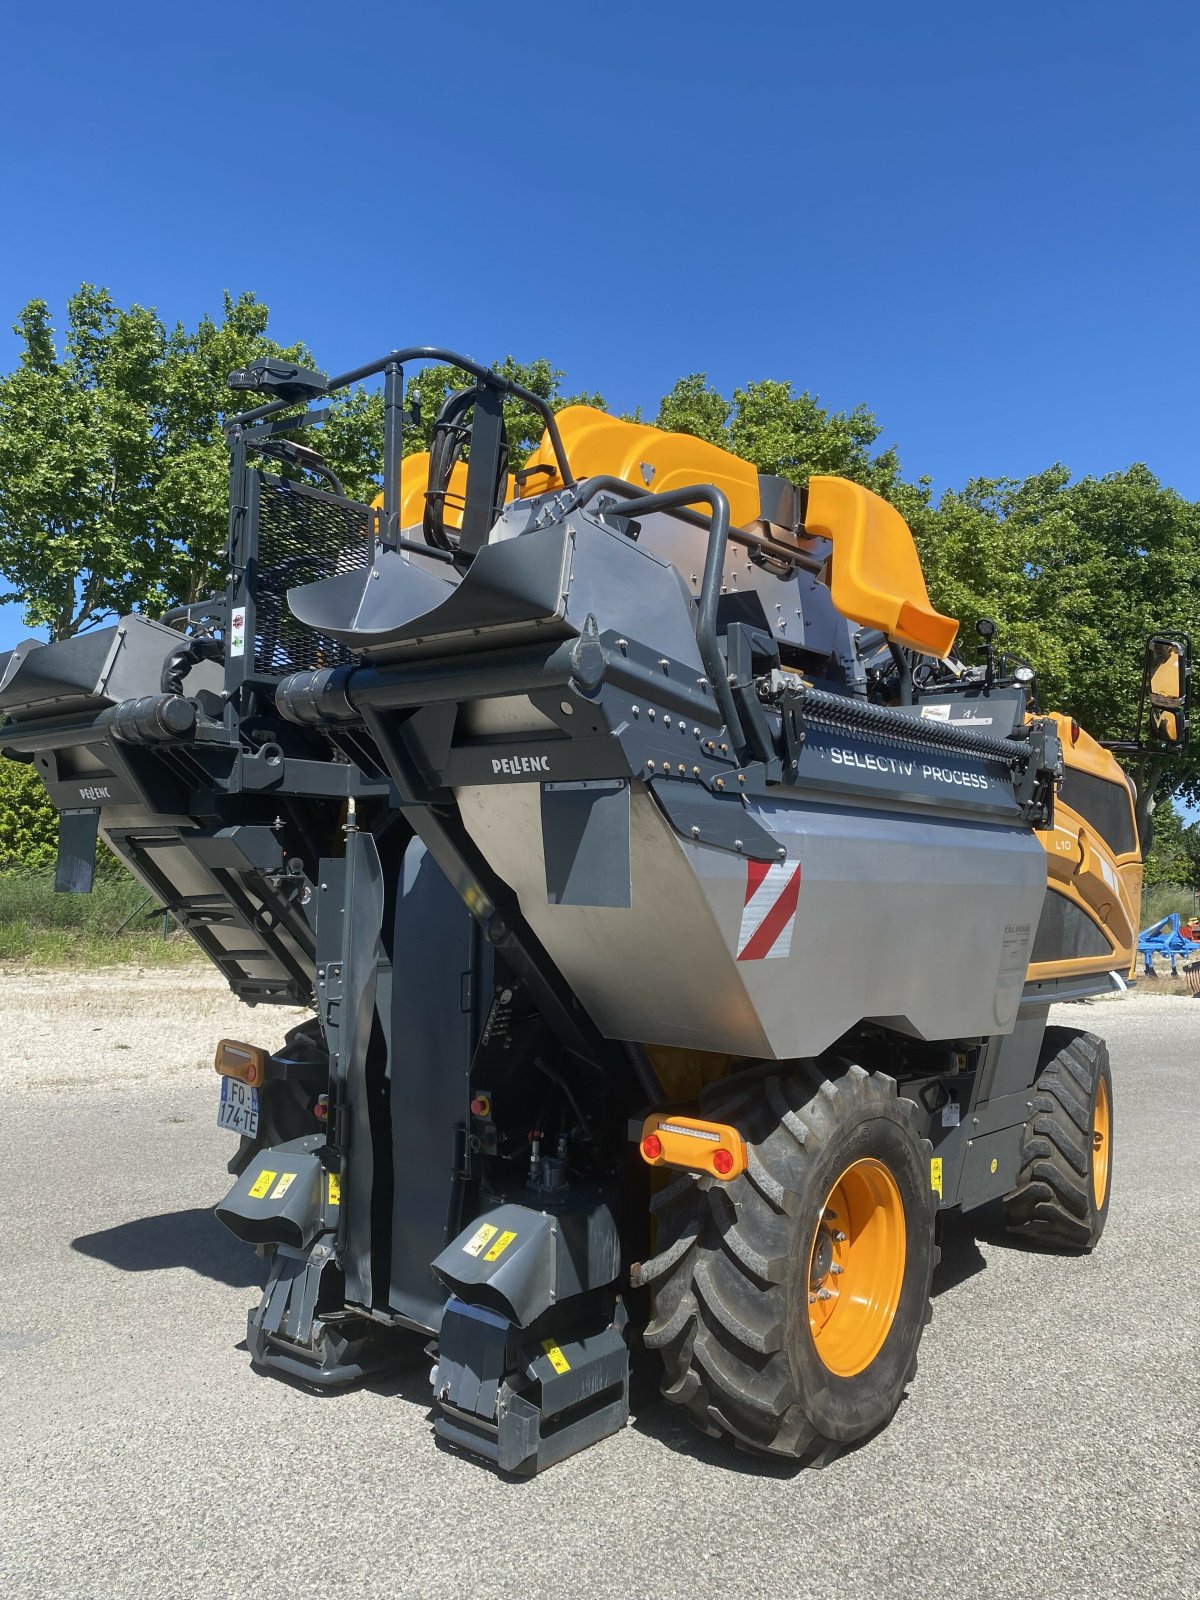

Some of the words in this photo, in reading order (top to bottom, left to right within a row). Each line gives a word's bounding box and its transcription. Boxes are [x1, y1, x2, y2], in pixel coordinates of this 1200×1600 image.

[491, 755, 551, 775] PELLENC
[922, 764, 988, 789] PROCESS
[79, 786, 111, 800] PELLENC
[1055, 840, 1071, 851] L10
[220, 1103, 258, 1134] 174-TE
